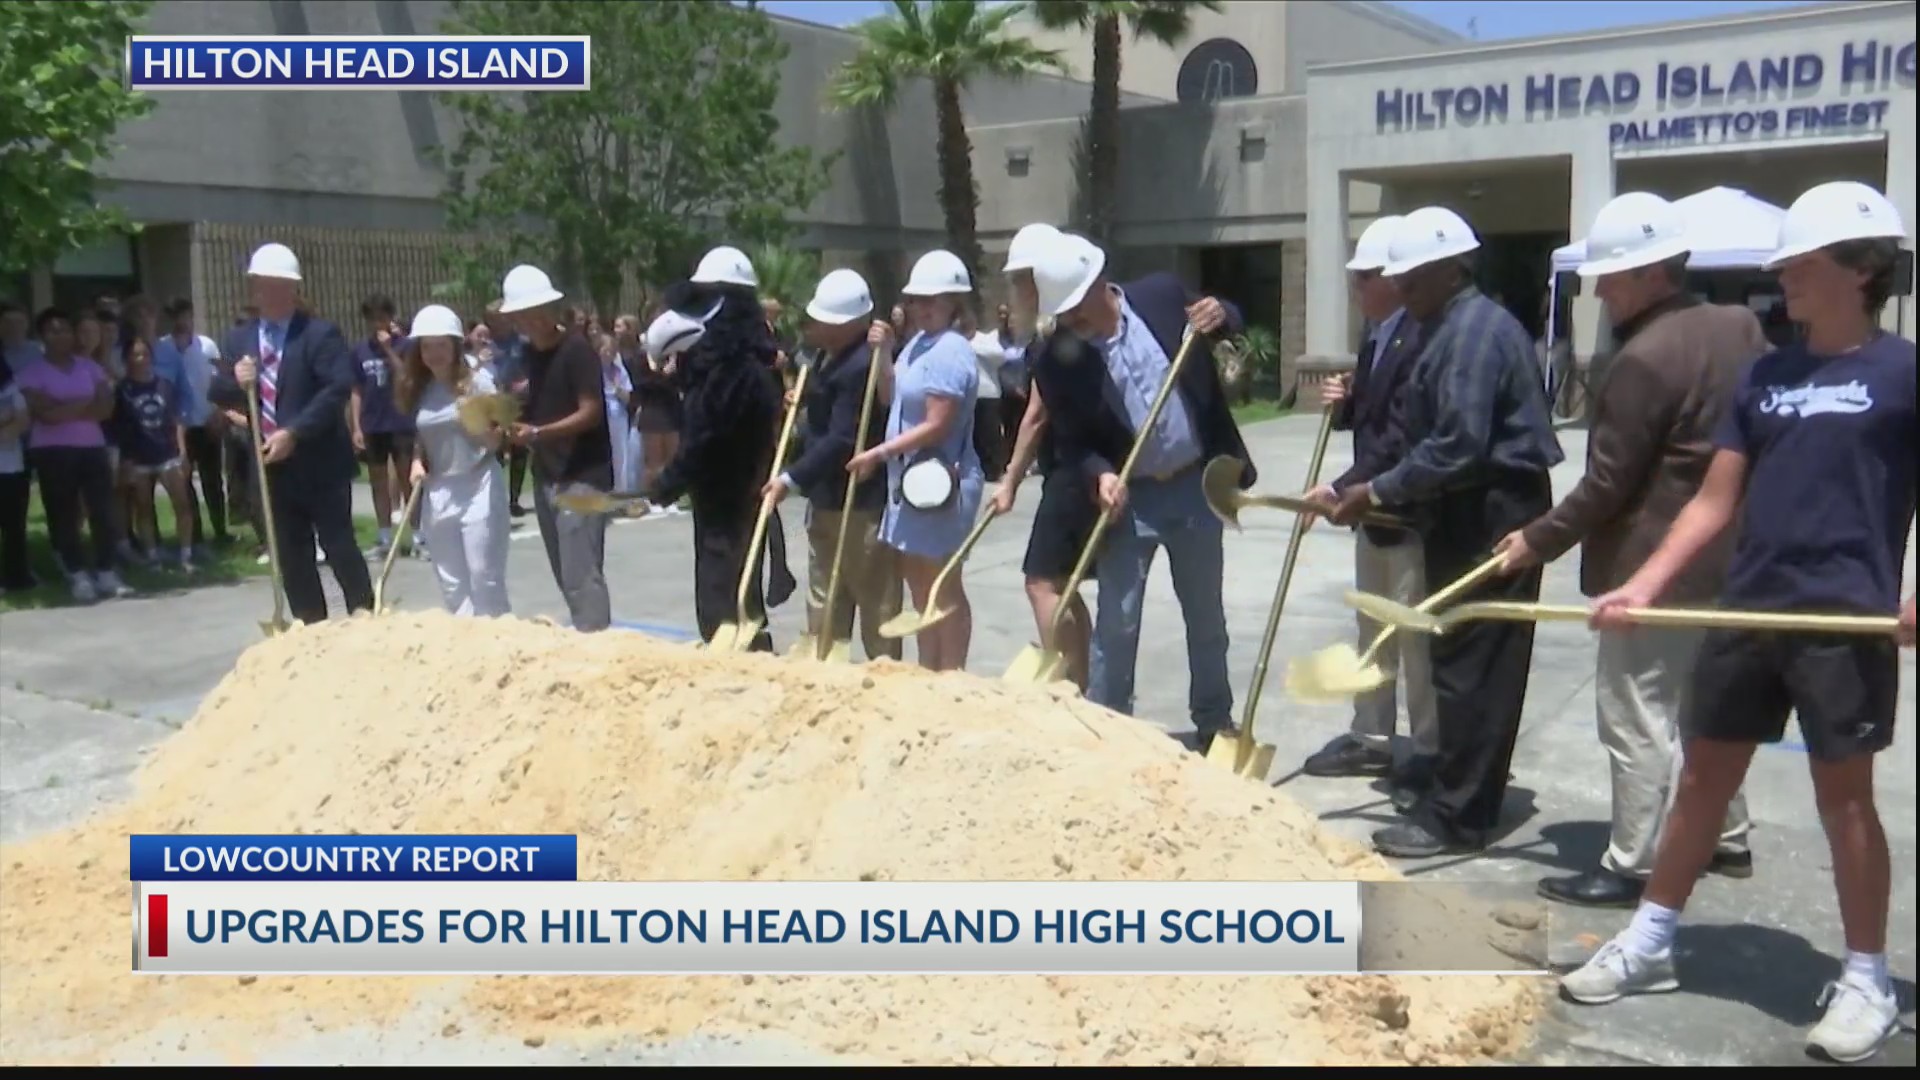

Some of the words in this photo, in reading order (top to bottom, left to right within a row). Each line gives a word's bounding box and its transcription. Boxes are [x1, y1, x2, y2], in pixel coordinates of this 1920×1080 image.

[1376, 83, 1509, 132] HILTON
[1524, 72, 1641, 121] HEAD
[1656, 53, 1824, 104] ISLAND
[1609, 108, 1779, 143] PALMETTO'S
[1785, 100, 1890, 135] FINEST
